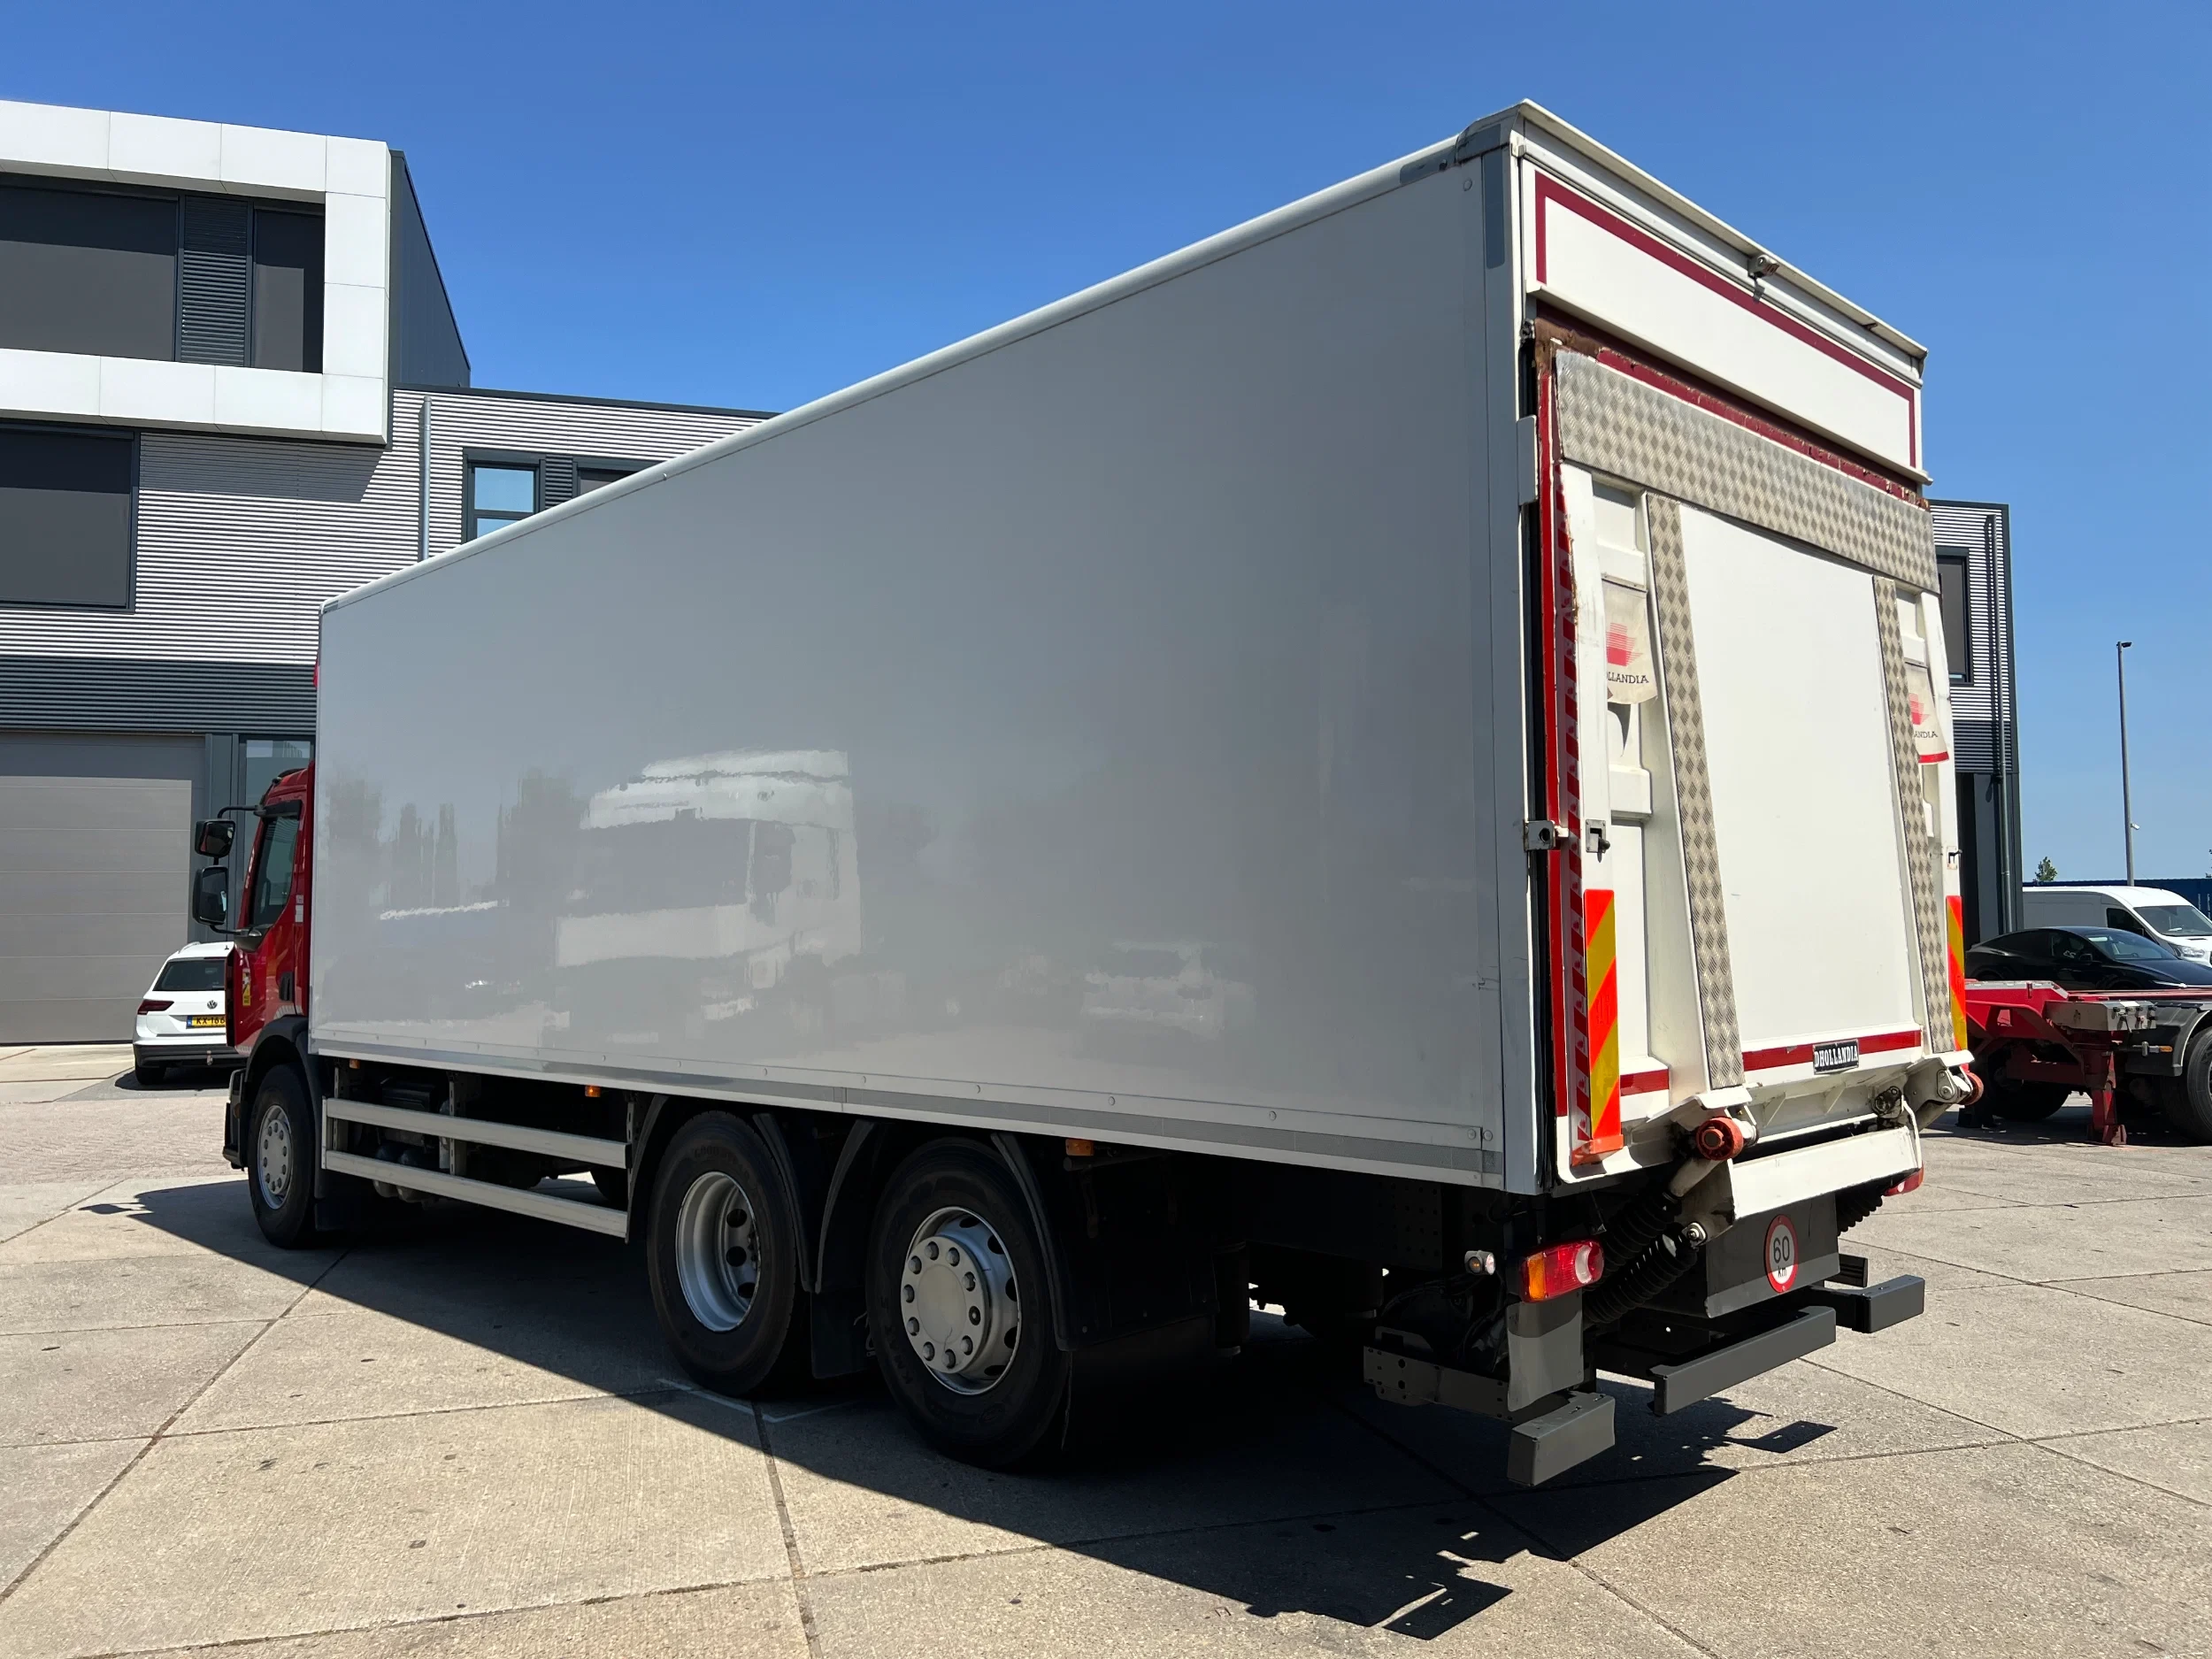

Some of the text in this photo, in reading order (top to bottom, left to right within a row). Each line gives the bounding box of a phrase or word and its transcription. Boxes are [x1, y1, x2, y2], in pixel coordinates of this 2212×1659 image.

[1814, 1046, 1858, 1067] DHOLLANDIA
[1773, 1235, 1790, 1263] 60
[1778, 1265, 1787, 1278] km
